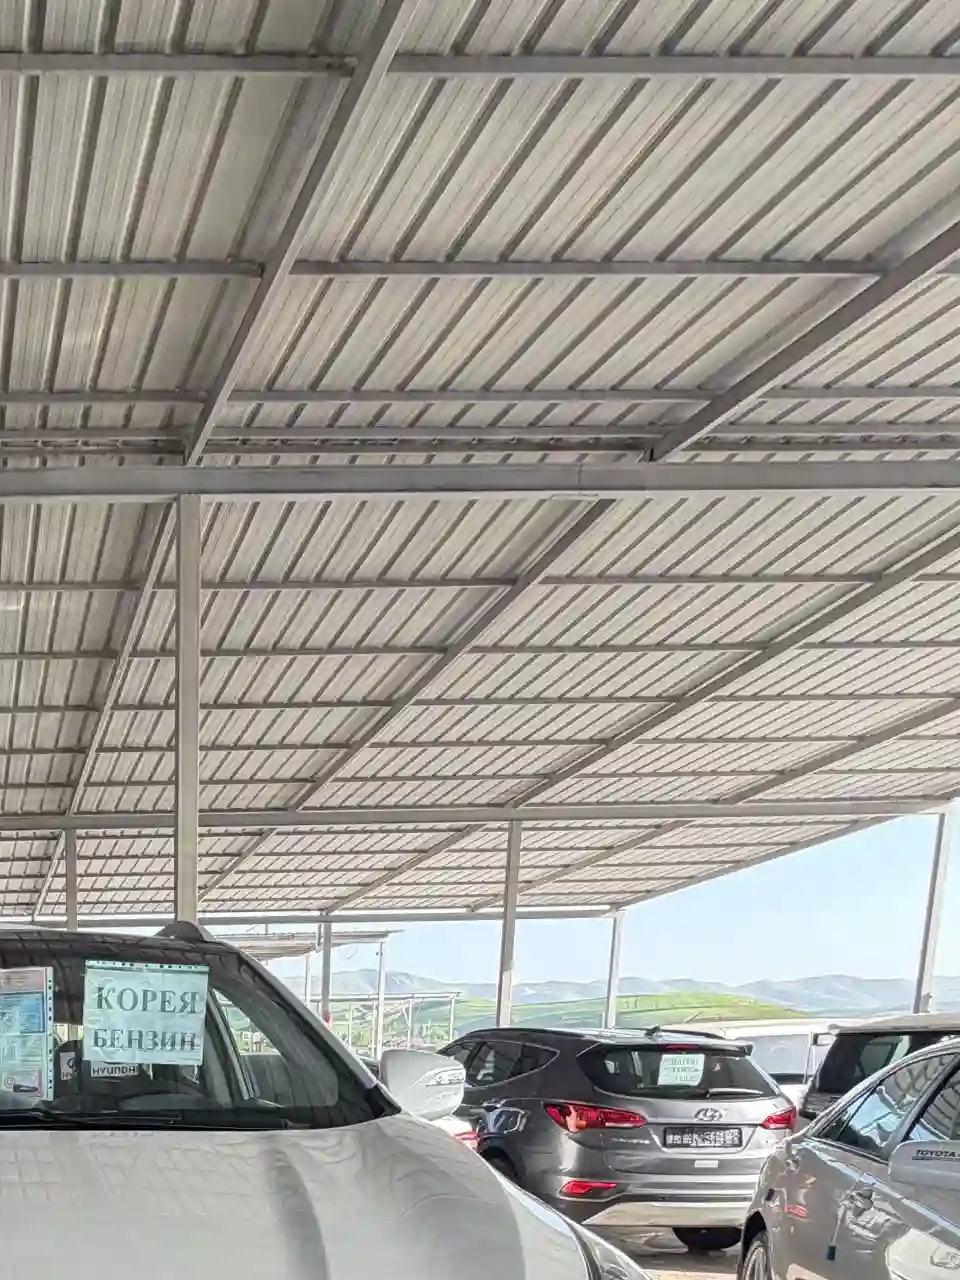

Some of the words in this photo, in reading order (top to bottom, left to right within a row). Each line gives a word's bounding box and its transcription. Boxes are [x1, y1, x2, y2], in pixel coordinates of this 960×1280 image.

[96, 986, 202, 1014] КОРЕЯ
[93, 1028, 197, 1051] БЕНЗИН
[916, 1149, 956, 1157] TOYOTA
